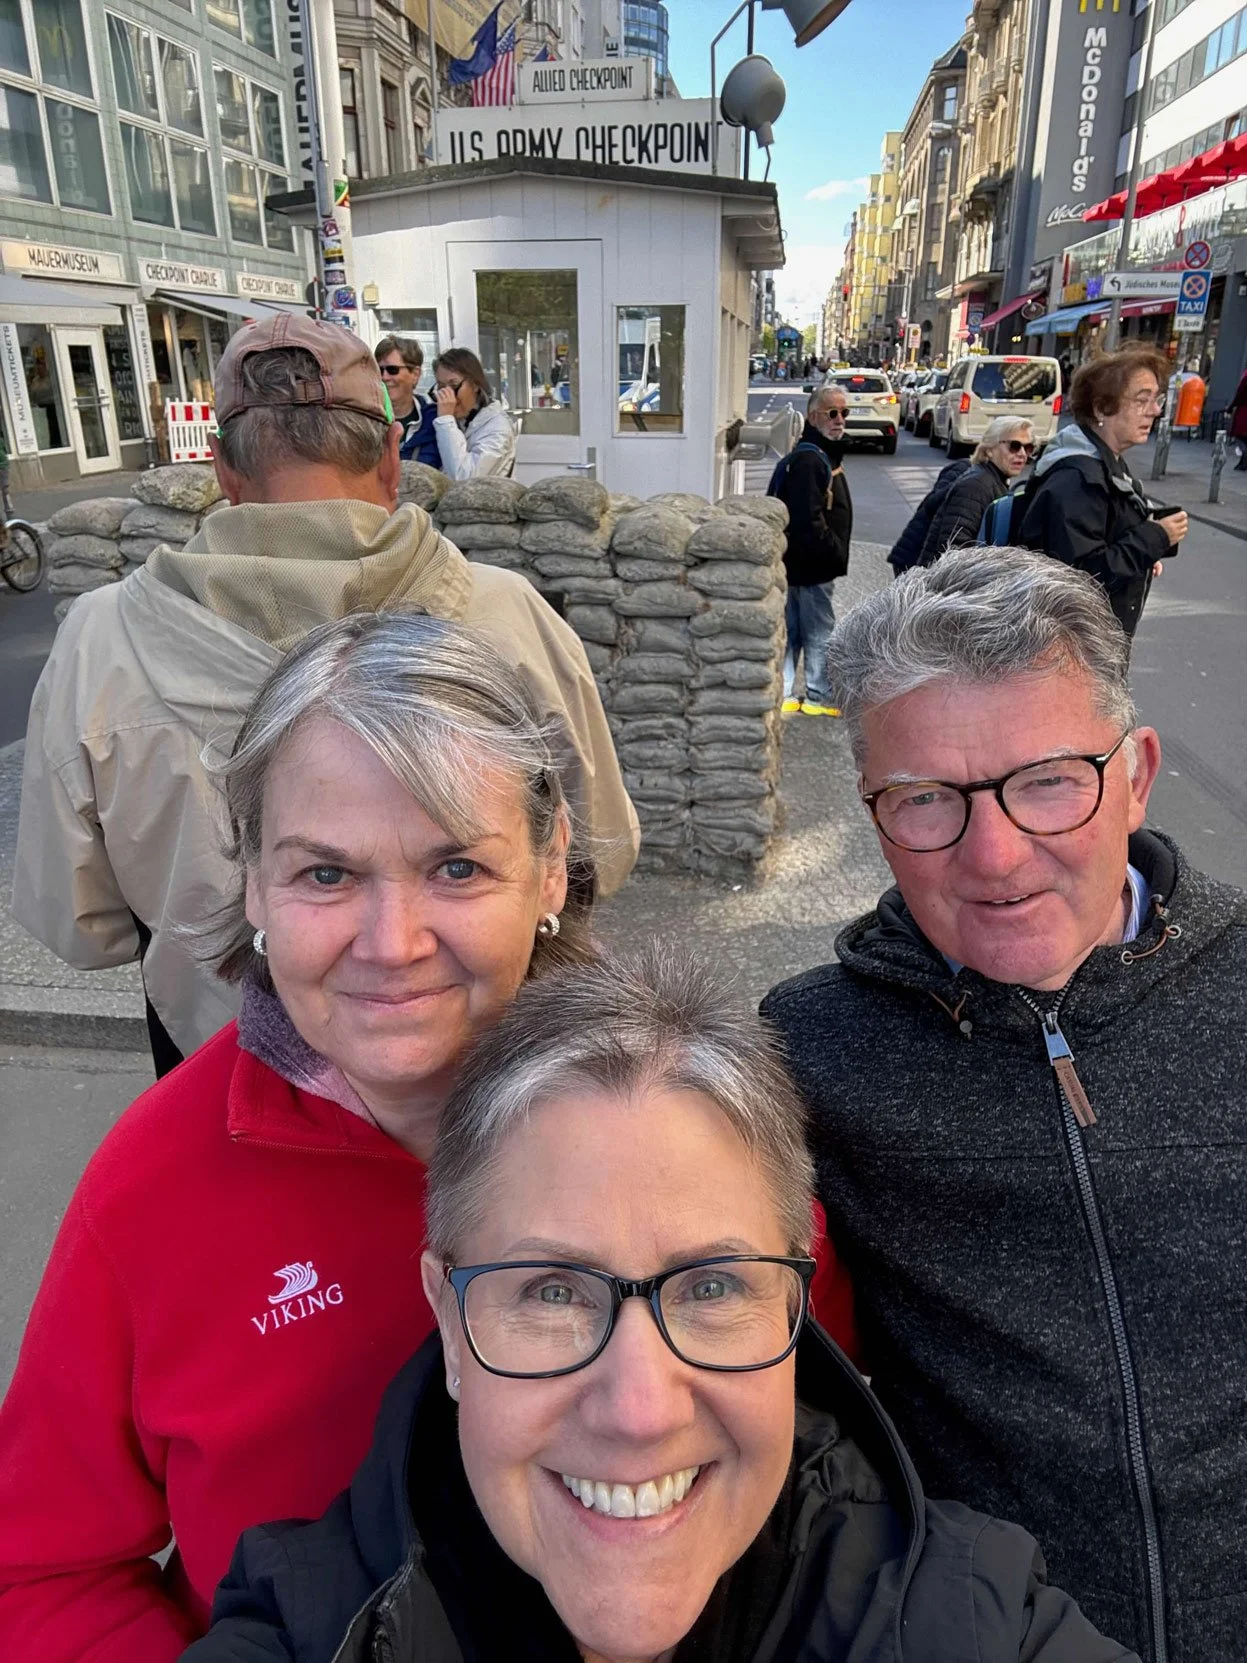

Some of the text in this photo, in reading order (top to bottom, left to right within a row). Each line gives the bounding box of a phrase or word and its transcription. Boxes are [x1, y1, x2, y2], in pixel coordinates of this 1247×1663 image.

[533, 65, 633, 92] ALLIED CHECKPOINT
[1071, 27, 1107, 192] McDonald's
[496, 127, 562, 159] ARMY
[28, 248, 100, 273] MAUERMUSEUM
[146, 264, 218, 288] CHECKPOINT CHARLIE
[241, 277, 296, 297] CHECKPOINT CHARLIE
[1180, 301, 1204, 312] TAXI
[250, 1283, 344, 1335] VIKING
